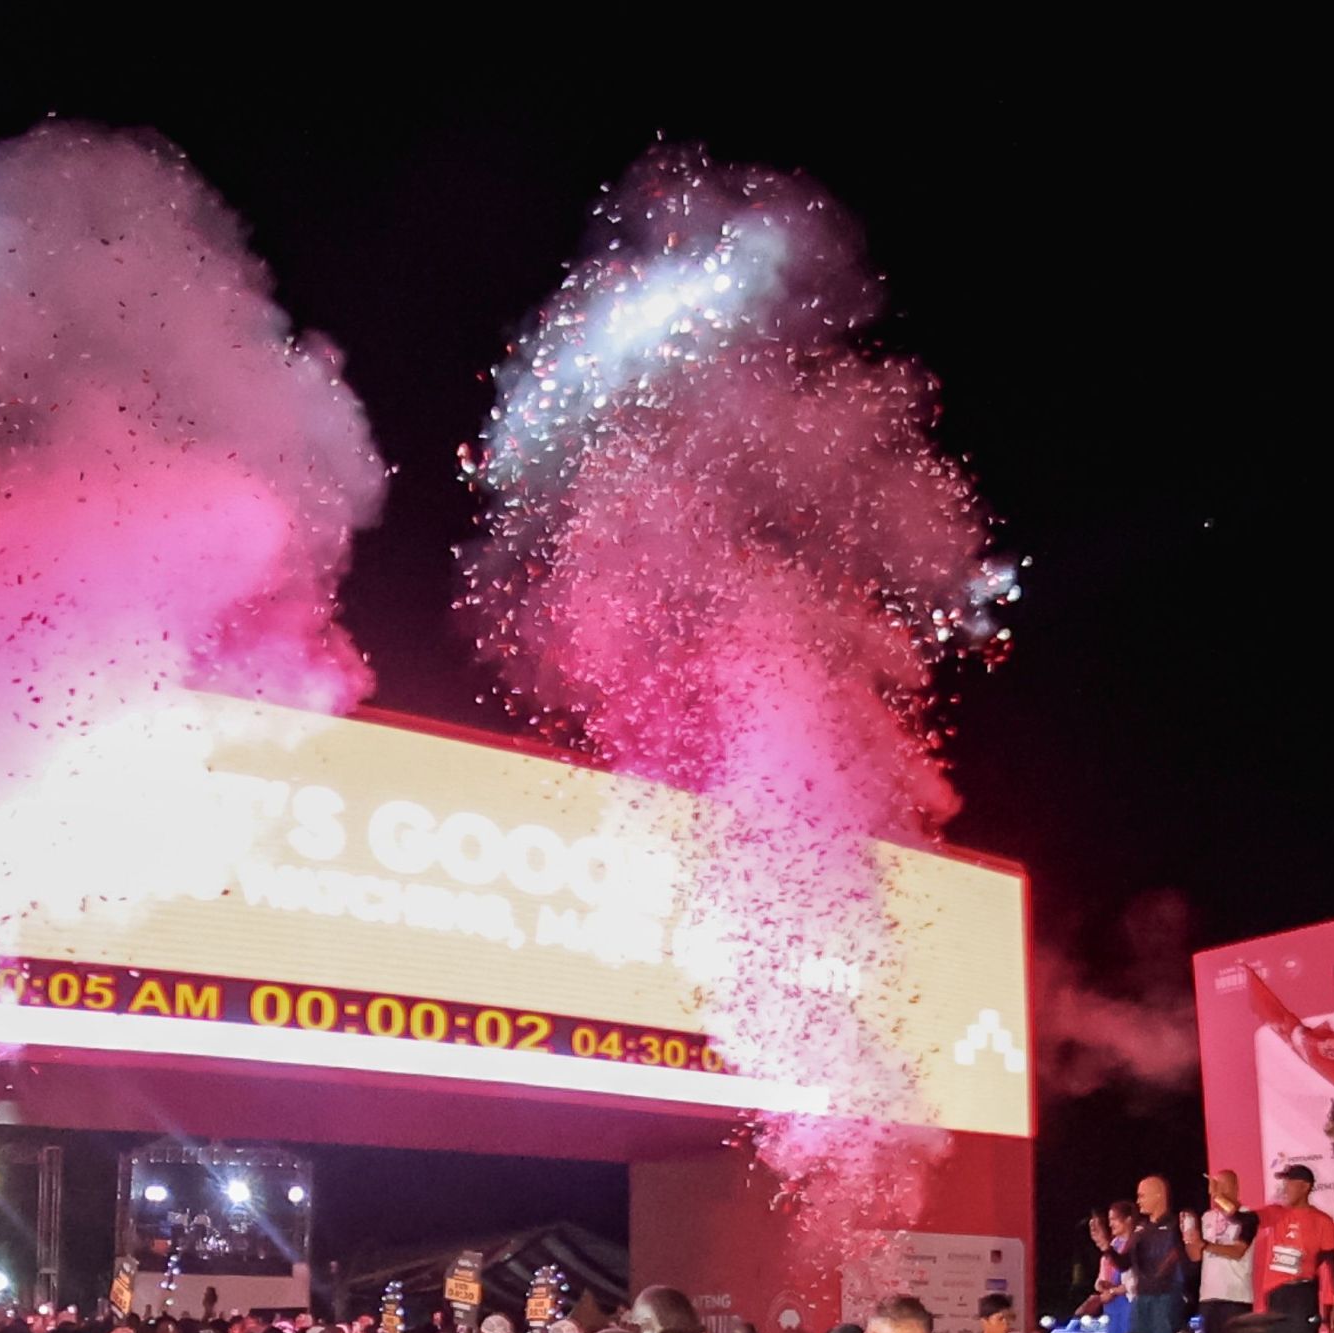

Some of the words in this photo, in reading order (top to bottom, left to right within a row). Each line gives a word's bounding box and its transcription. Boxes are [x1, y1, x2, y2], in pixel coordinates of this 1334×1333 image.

[127, 979, 222, 1020] AM
[249, 985, 552, 1055] 00:00:02
[571, 1027, 726, 1074] 04:30:0
